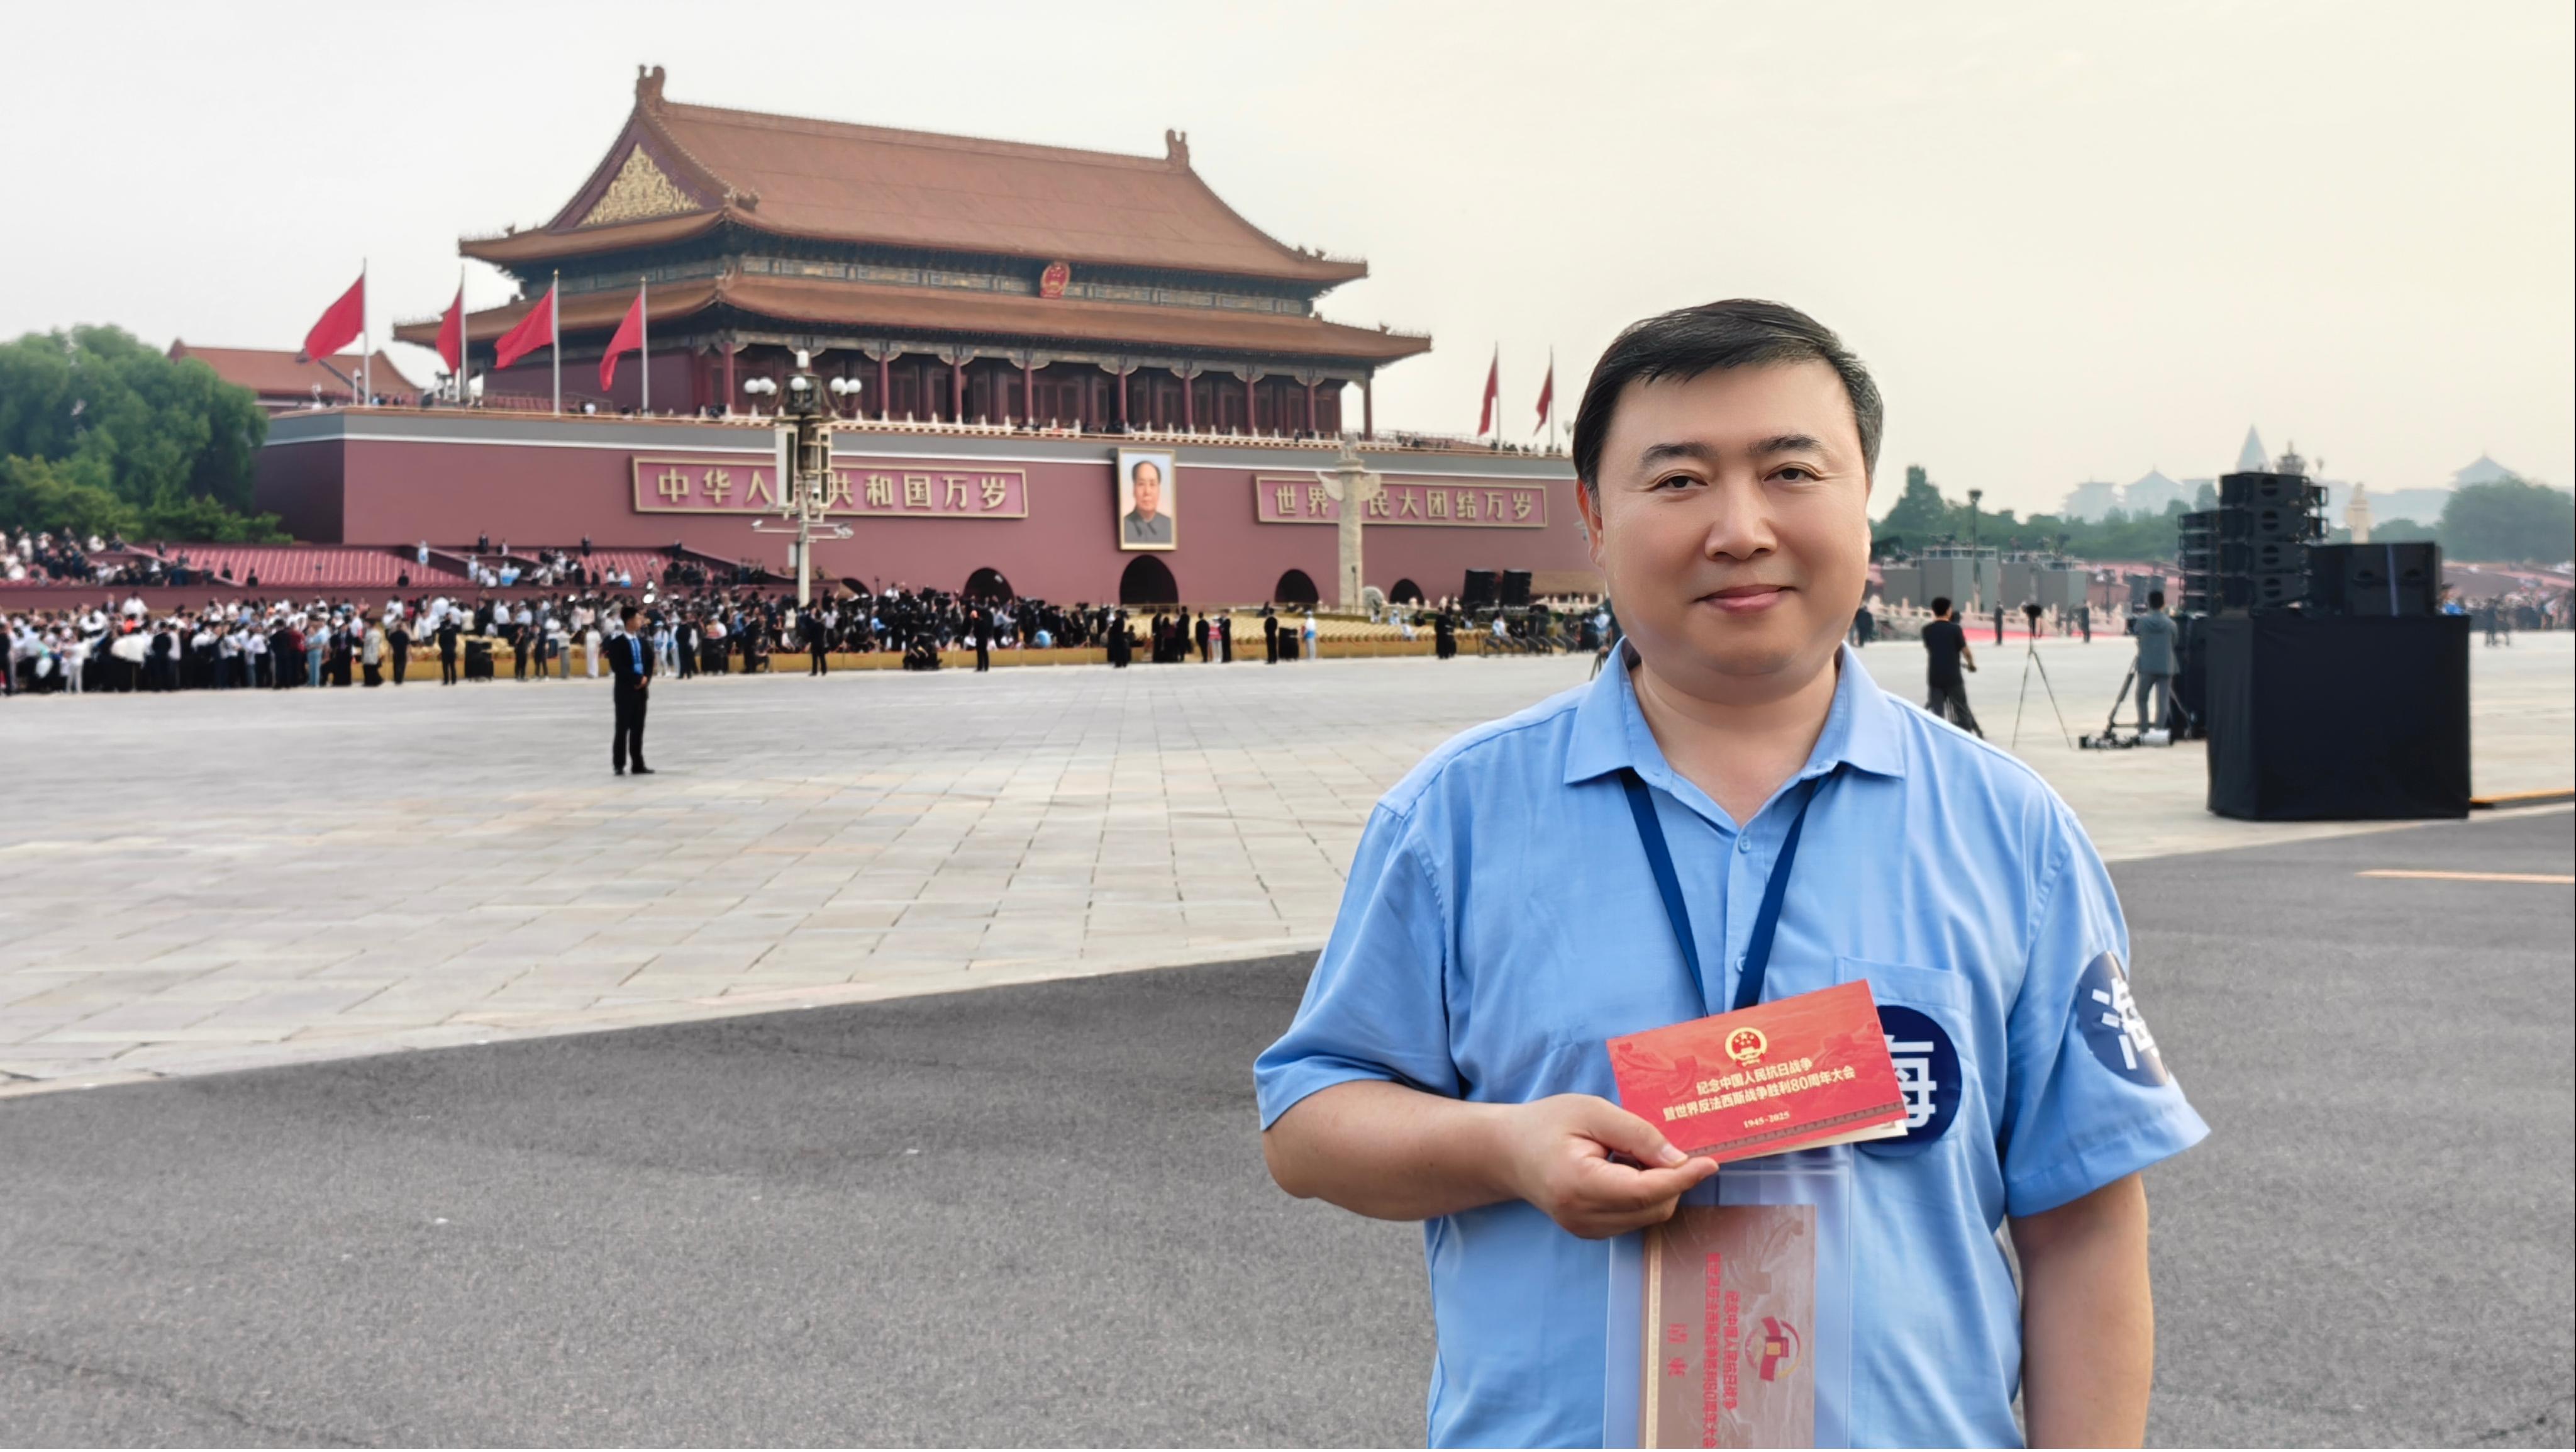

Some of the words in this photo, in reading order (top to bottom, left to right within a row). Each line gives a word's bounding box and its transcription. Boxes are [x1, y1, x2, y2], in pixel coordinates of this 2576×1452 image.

[658, 467, 1008, 511] 中华人共和国万岁
[1275, 484, 1533, 520] 世界民大团结万岁
[1663, 1066, 1855, 1121] 暨世界反法西斯战争胜利80周年大会
[1696, 1056, 1813, 1096] 纪念中国人民抗日战争
